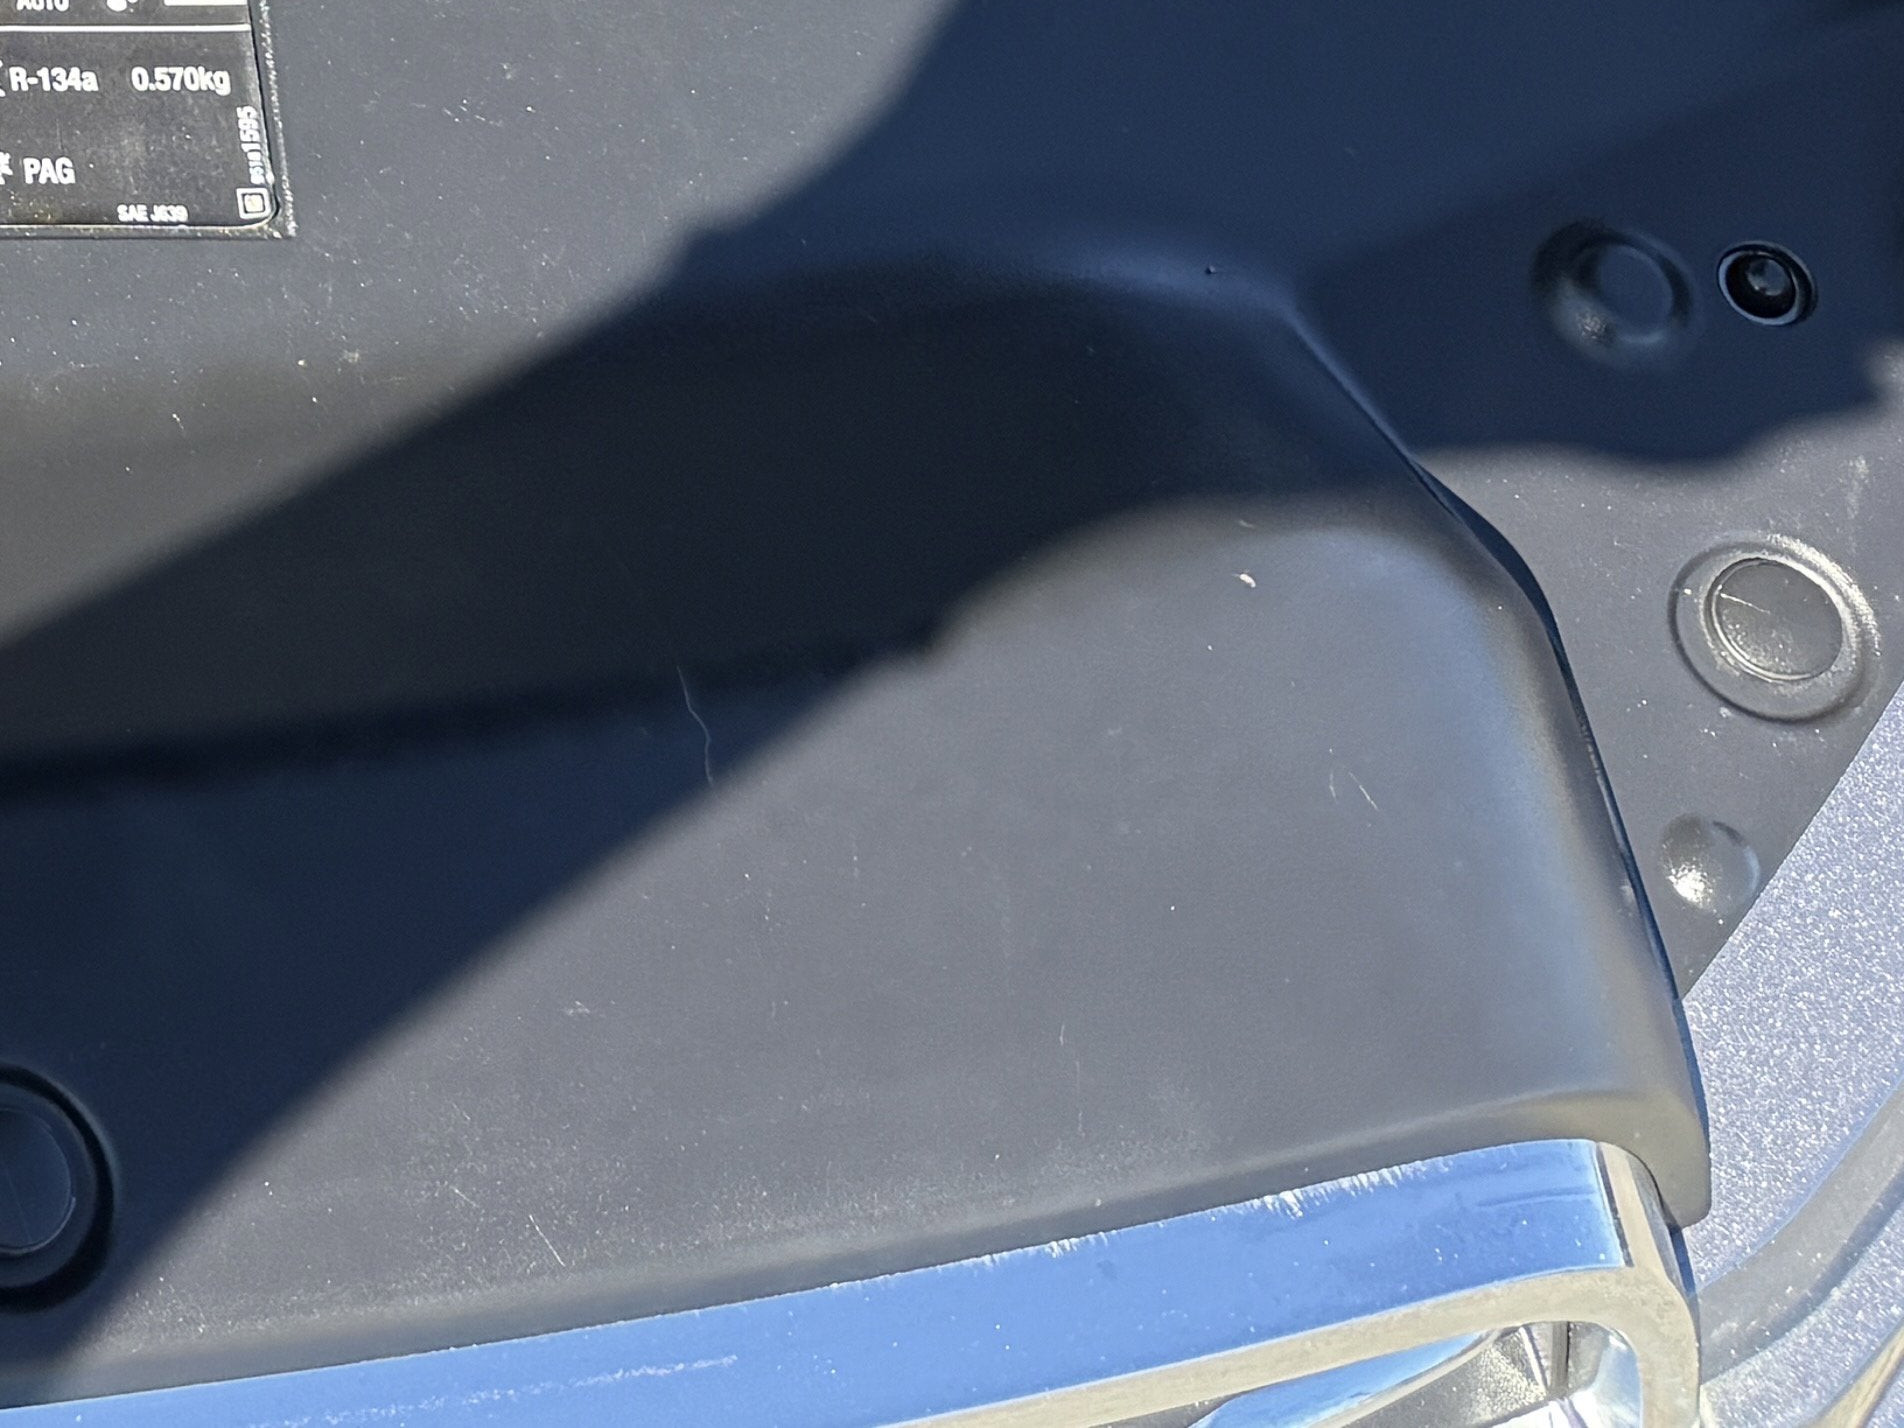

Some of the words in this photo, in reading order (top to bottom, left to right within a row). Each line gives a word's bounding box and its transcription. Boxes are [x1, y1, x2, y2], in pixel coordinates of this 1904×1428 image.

[8, 67, 99, 93] R-134a
[130, 66, 231, 96] 0.570kg
[22, 157, 77, 185] PAG
[116, 204, 149, 223] SAE
